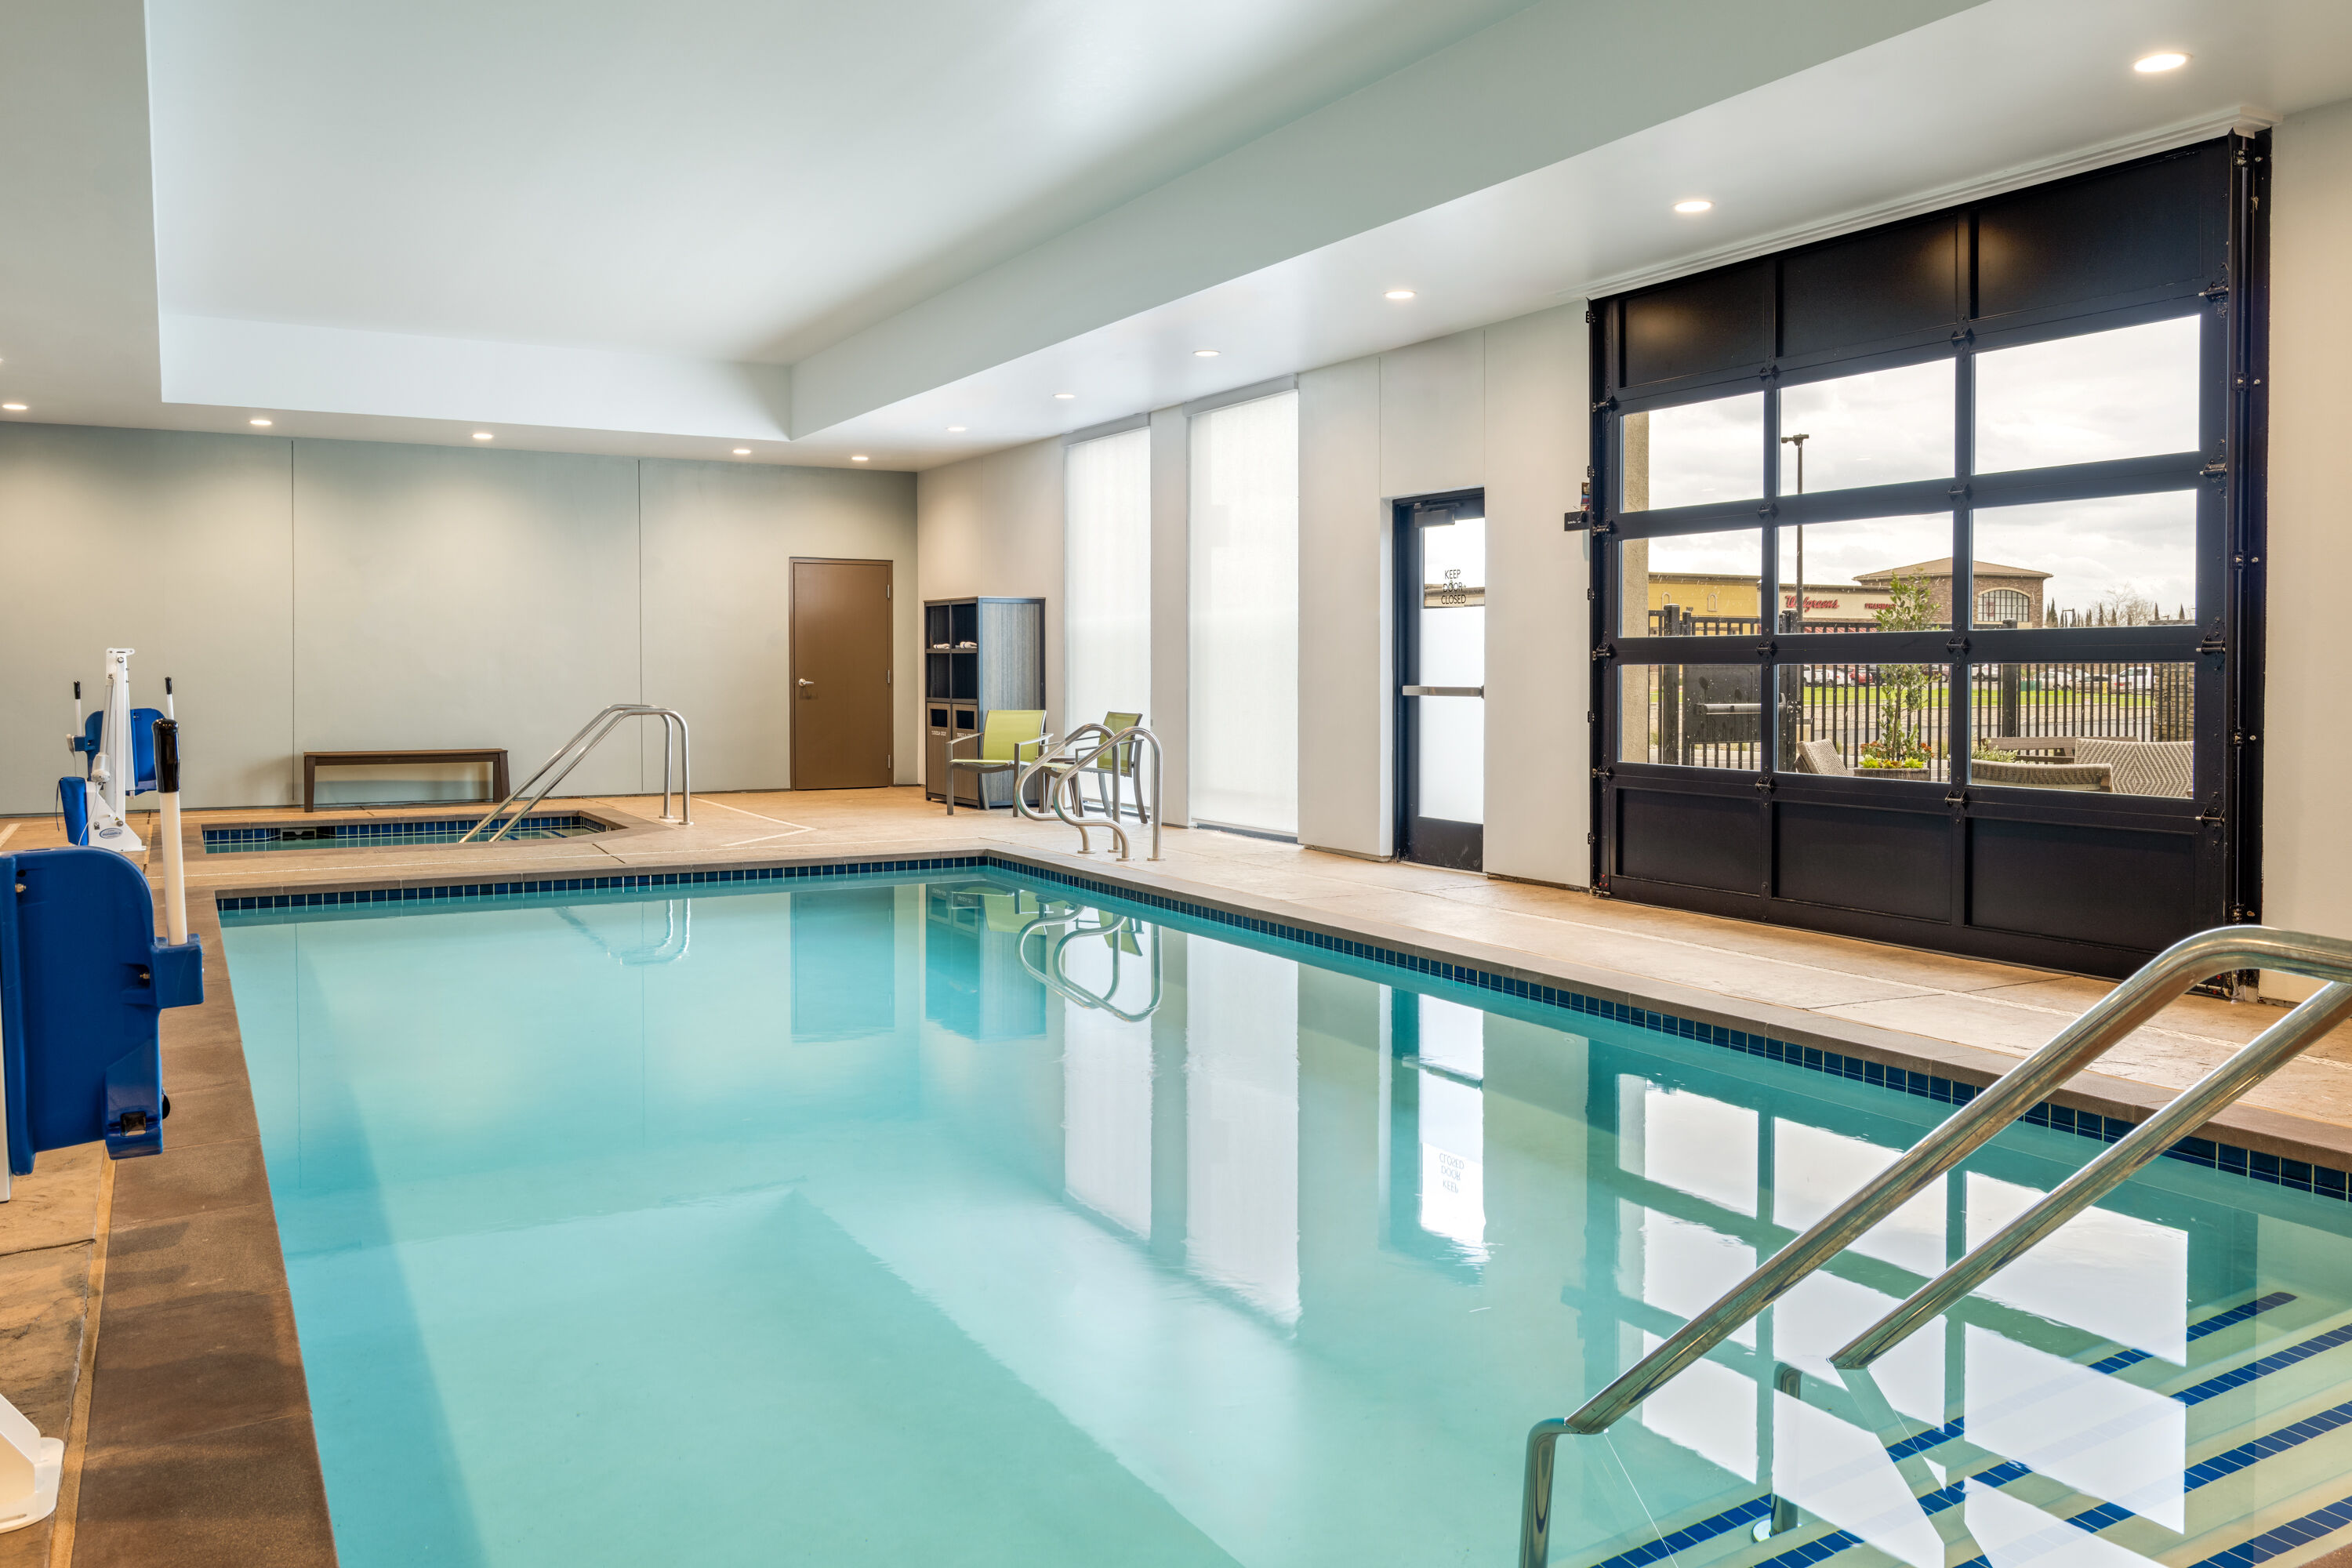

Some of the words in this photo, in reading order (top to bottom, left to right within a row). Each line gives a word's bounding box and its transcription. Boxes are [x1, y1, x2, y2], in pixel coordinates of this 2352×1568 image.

[1445, 569, 1461, 579] KEEP
[1443, 583, 1463, 592] DOOR
[1441, 594, 1466, 604] CLOSED
[1785, 595, 1840, 612] Wlgreens
